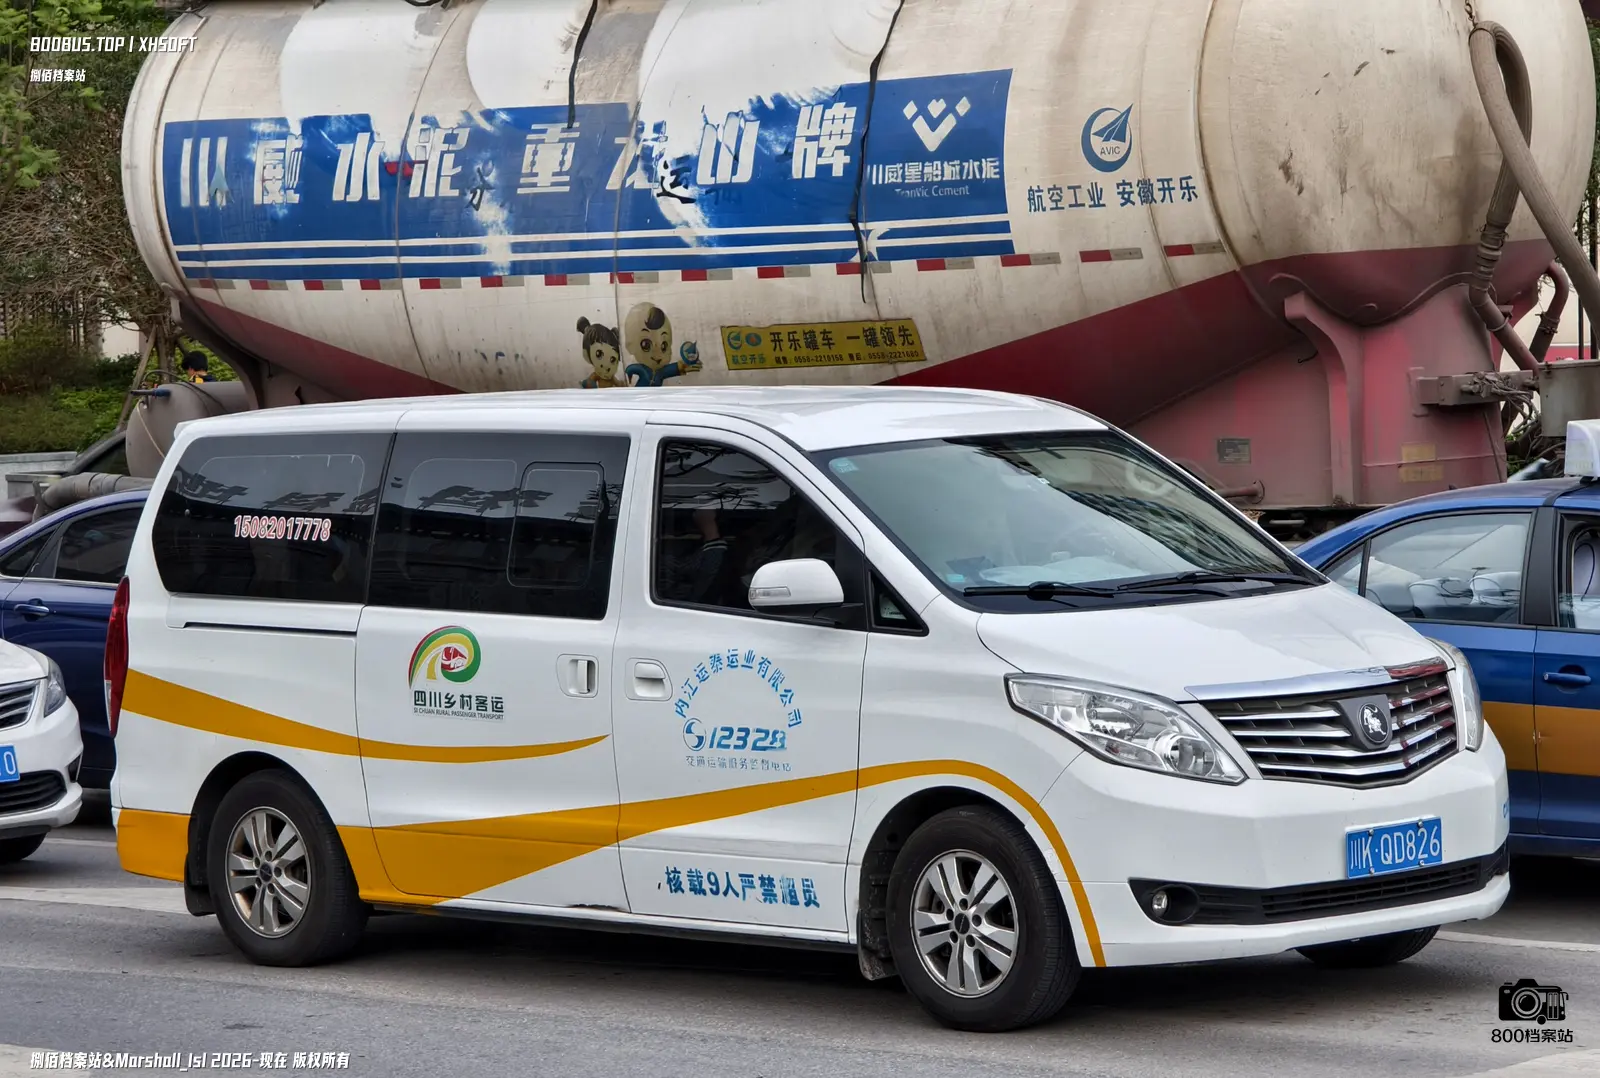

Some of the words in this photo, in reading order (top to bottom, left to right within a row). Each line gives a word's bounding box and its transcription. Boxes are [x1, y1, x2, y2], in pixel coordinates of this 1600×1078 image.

[1099, 145, 1121, 156] AVIC
[931, 184, 971, 198] Cement
[1026, 181, 1107, 214] 航空工业
[1115, 174, 1199, 208] 安徽开乐
[769, 328, 836, 352] 开乐罐车
[846, 325, 916, 349] 一罐领先
[234, 514, 332, 542] 15082017778
[413, 689, 505, 714] 四川乡村客运
[674, 648, 803, 729] 内江运泰运业有限公司
[419, 707, 435, 715] CHUAN
[436, 708, 451, 716] RURAL
[451, 710, 478, 719] PASSENGER
[478, 712, 504, 721] TRANSPORT
[708, 726, 787, 752] 12328
